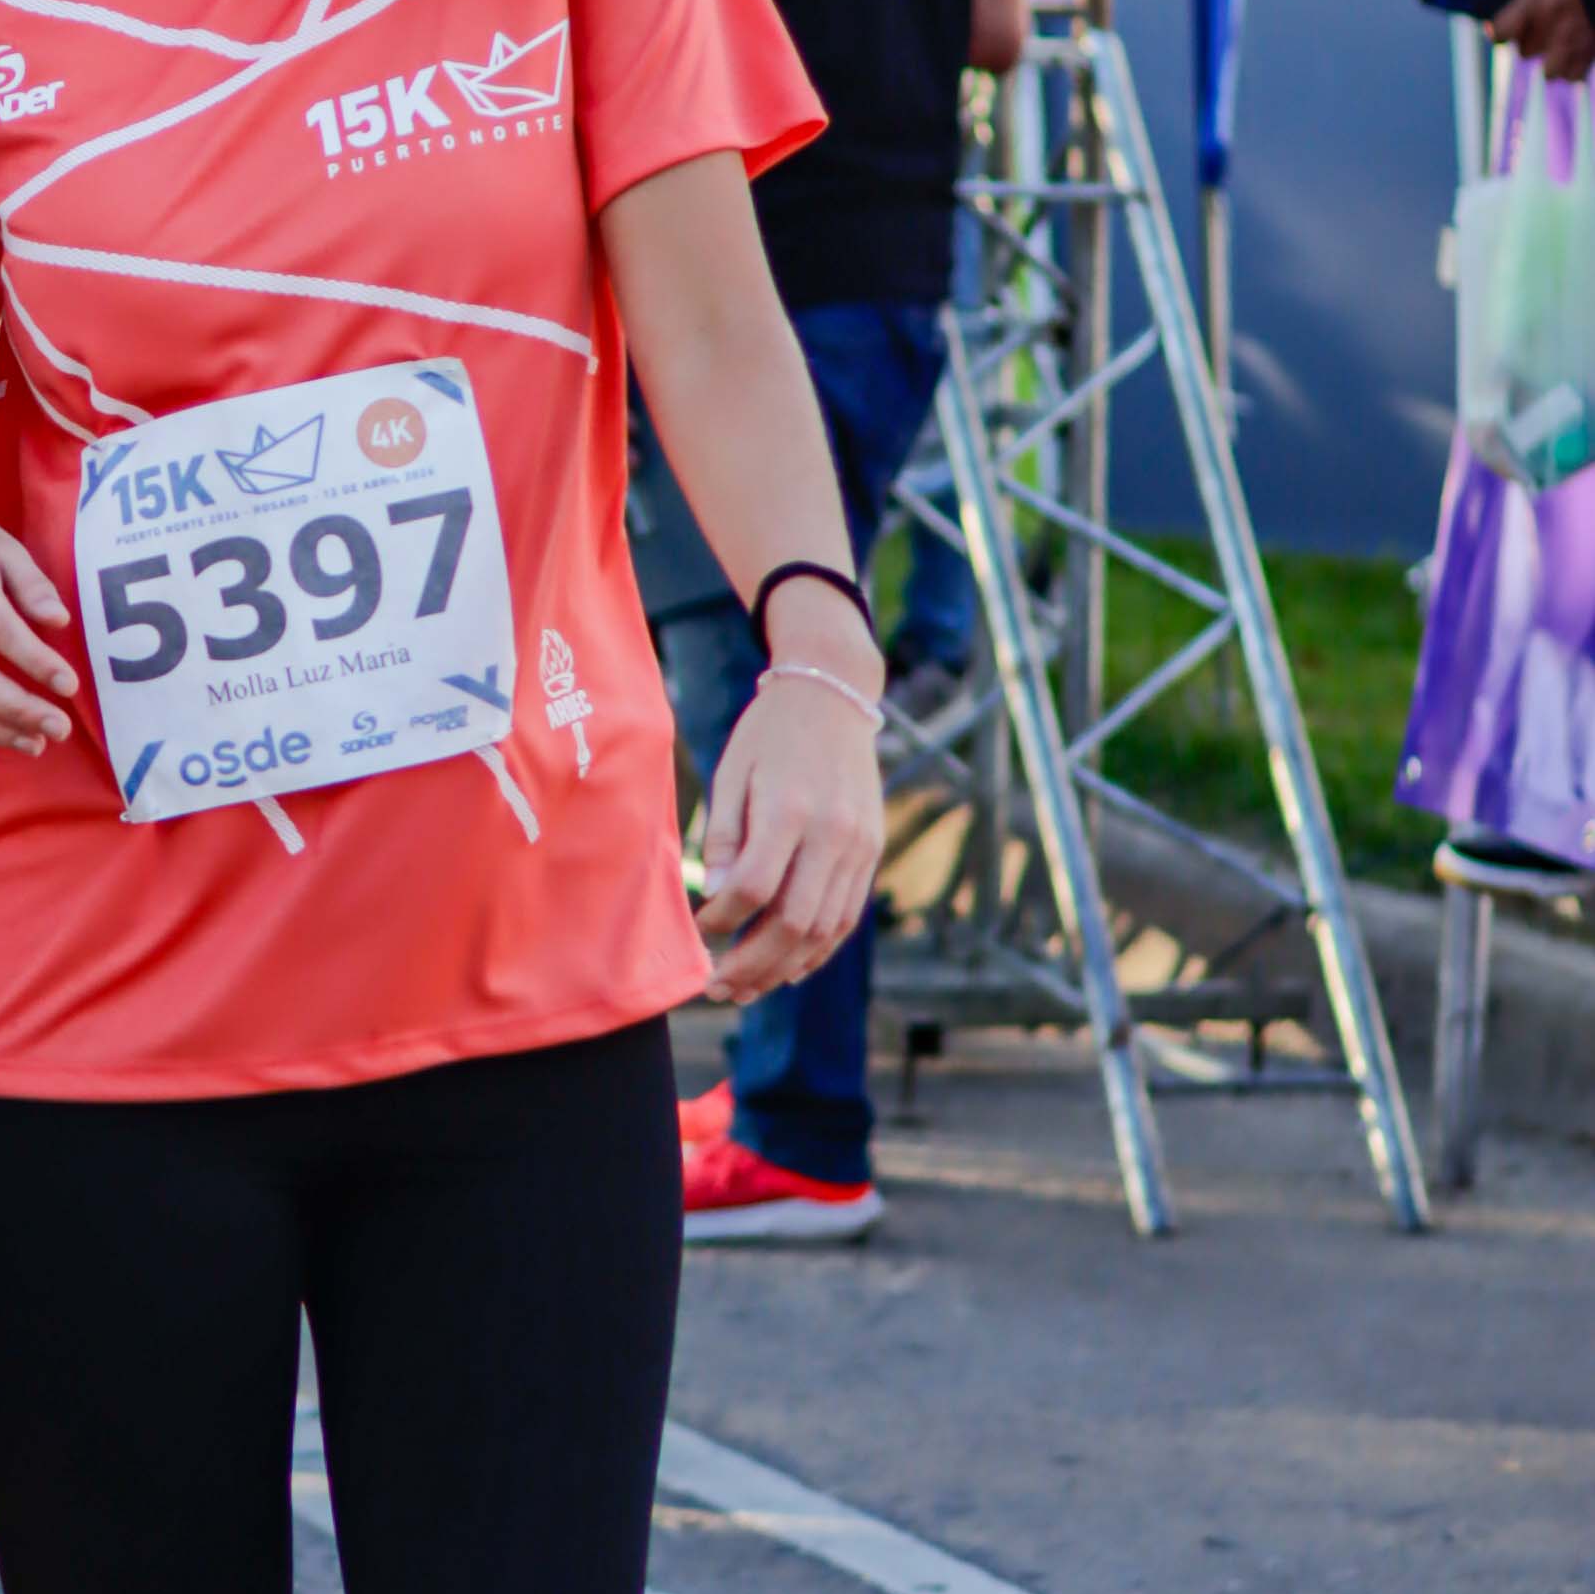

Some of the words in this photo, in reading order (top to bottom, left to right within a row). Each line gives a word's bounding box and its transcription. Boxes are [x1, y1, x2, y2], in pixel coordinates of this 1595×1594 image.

[305, 65, 451, 157] 15K
[326, 134, 455, 180] PUERTO
[469, 114, 563, 145] NORTE
[370, 416, 415, 448] 4K
[111, 453, 216, 526] 15K
[97, 486, 474, 684] 5397
[206, 672, 279, 706] Molla
[285, 664, 335, 689] Luz
[179, 725, 312, 788] osde
